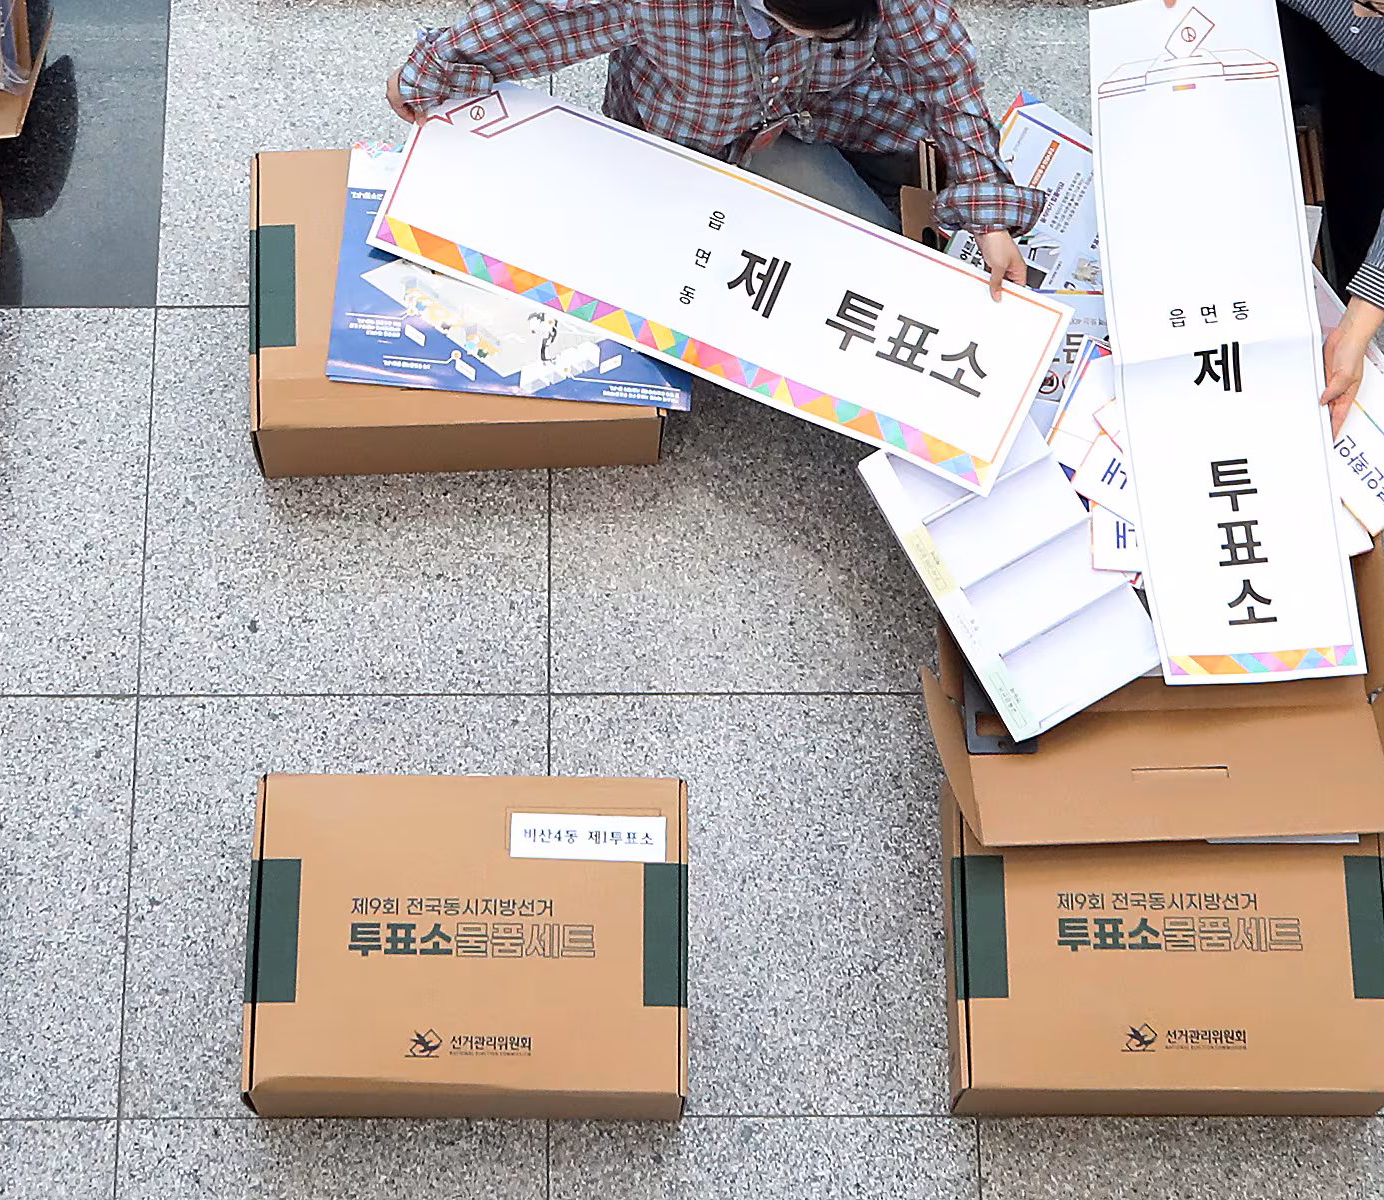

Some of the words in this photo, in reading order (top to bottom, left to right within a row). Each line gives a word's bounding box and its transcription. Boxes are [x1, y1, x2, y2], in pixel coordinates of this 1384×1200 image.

[695, 247, 712, 270] 면
[679, 285, 696, 305] 동
[727, 249, 792, 319] 제
[825, 289, 988, 398] 투표소
[1169, 308, 1186, 328] 읍
[1200, 304, 1218, 325] 면
[1233, 301, 1250, 321] 동
[1193, 341, 1243, 392] 제
[1209, 459, 1277, 628] 투표소
[524, 828, 578, 844] 비산4동
[587, 830, 654, 846] 제1투표소
[351, 898, 399, 915] 제9회
[406, 898, 553, 917] 전국동시지방선거
[1057, 893, 1105, 910] 제9회
[1112, 893, 1258, 911] 전국동시지방선거
[349, 923, 595, 958] 투표소물품세트
[1057, 917, 1303, 951] 투표소물품세트
[450, 1036, 532, 1051] 선거관리위원회
[1165, 1028, 1247, 1044] 선거관리위원회
